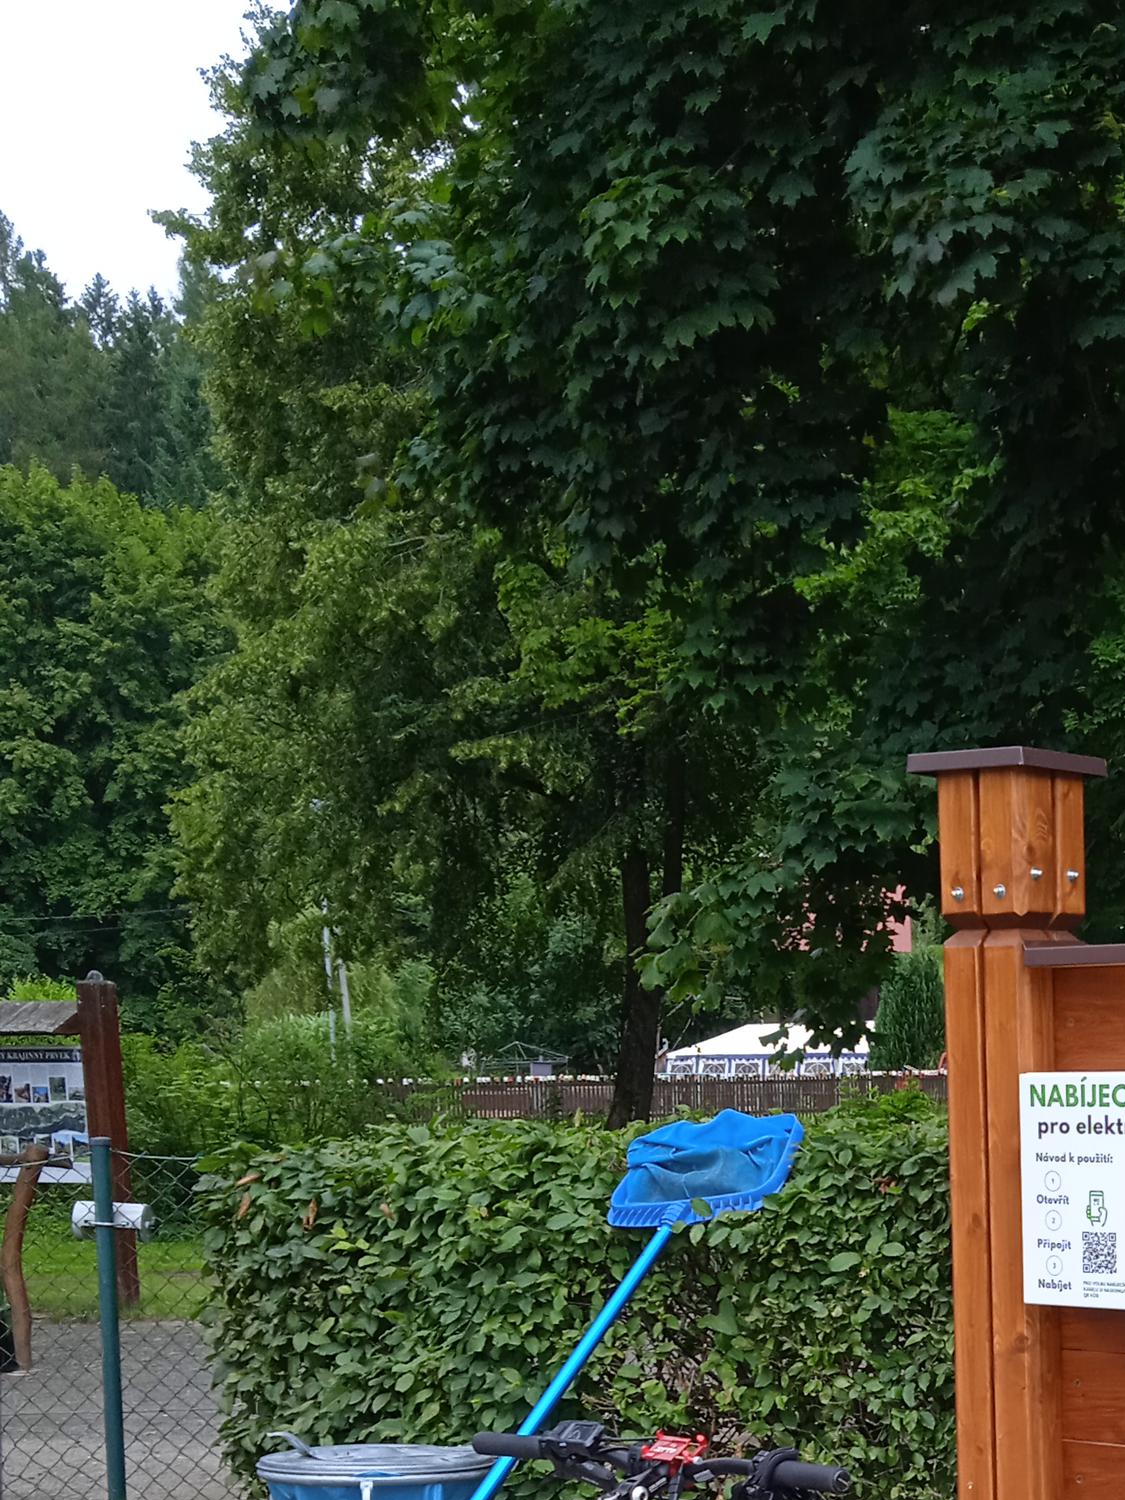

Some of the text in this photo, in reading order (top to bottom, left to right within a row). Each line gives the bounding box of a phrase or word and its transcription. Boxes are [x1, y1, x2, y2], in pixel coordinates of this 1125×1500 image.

[1038, 1119, 1070, 1139] pro
[1035, 1152, 1114, 1165] Návod k použití:
[1037, 1238, 1072, 1251] Připojit
[1038, 1278, 1072, 1292] Nabíjet
